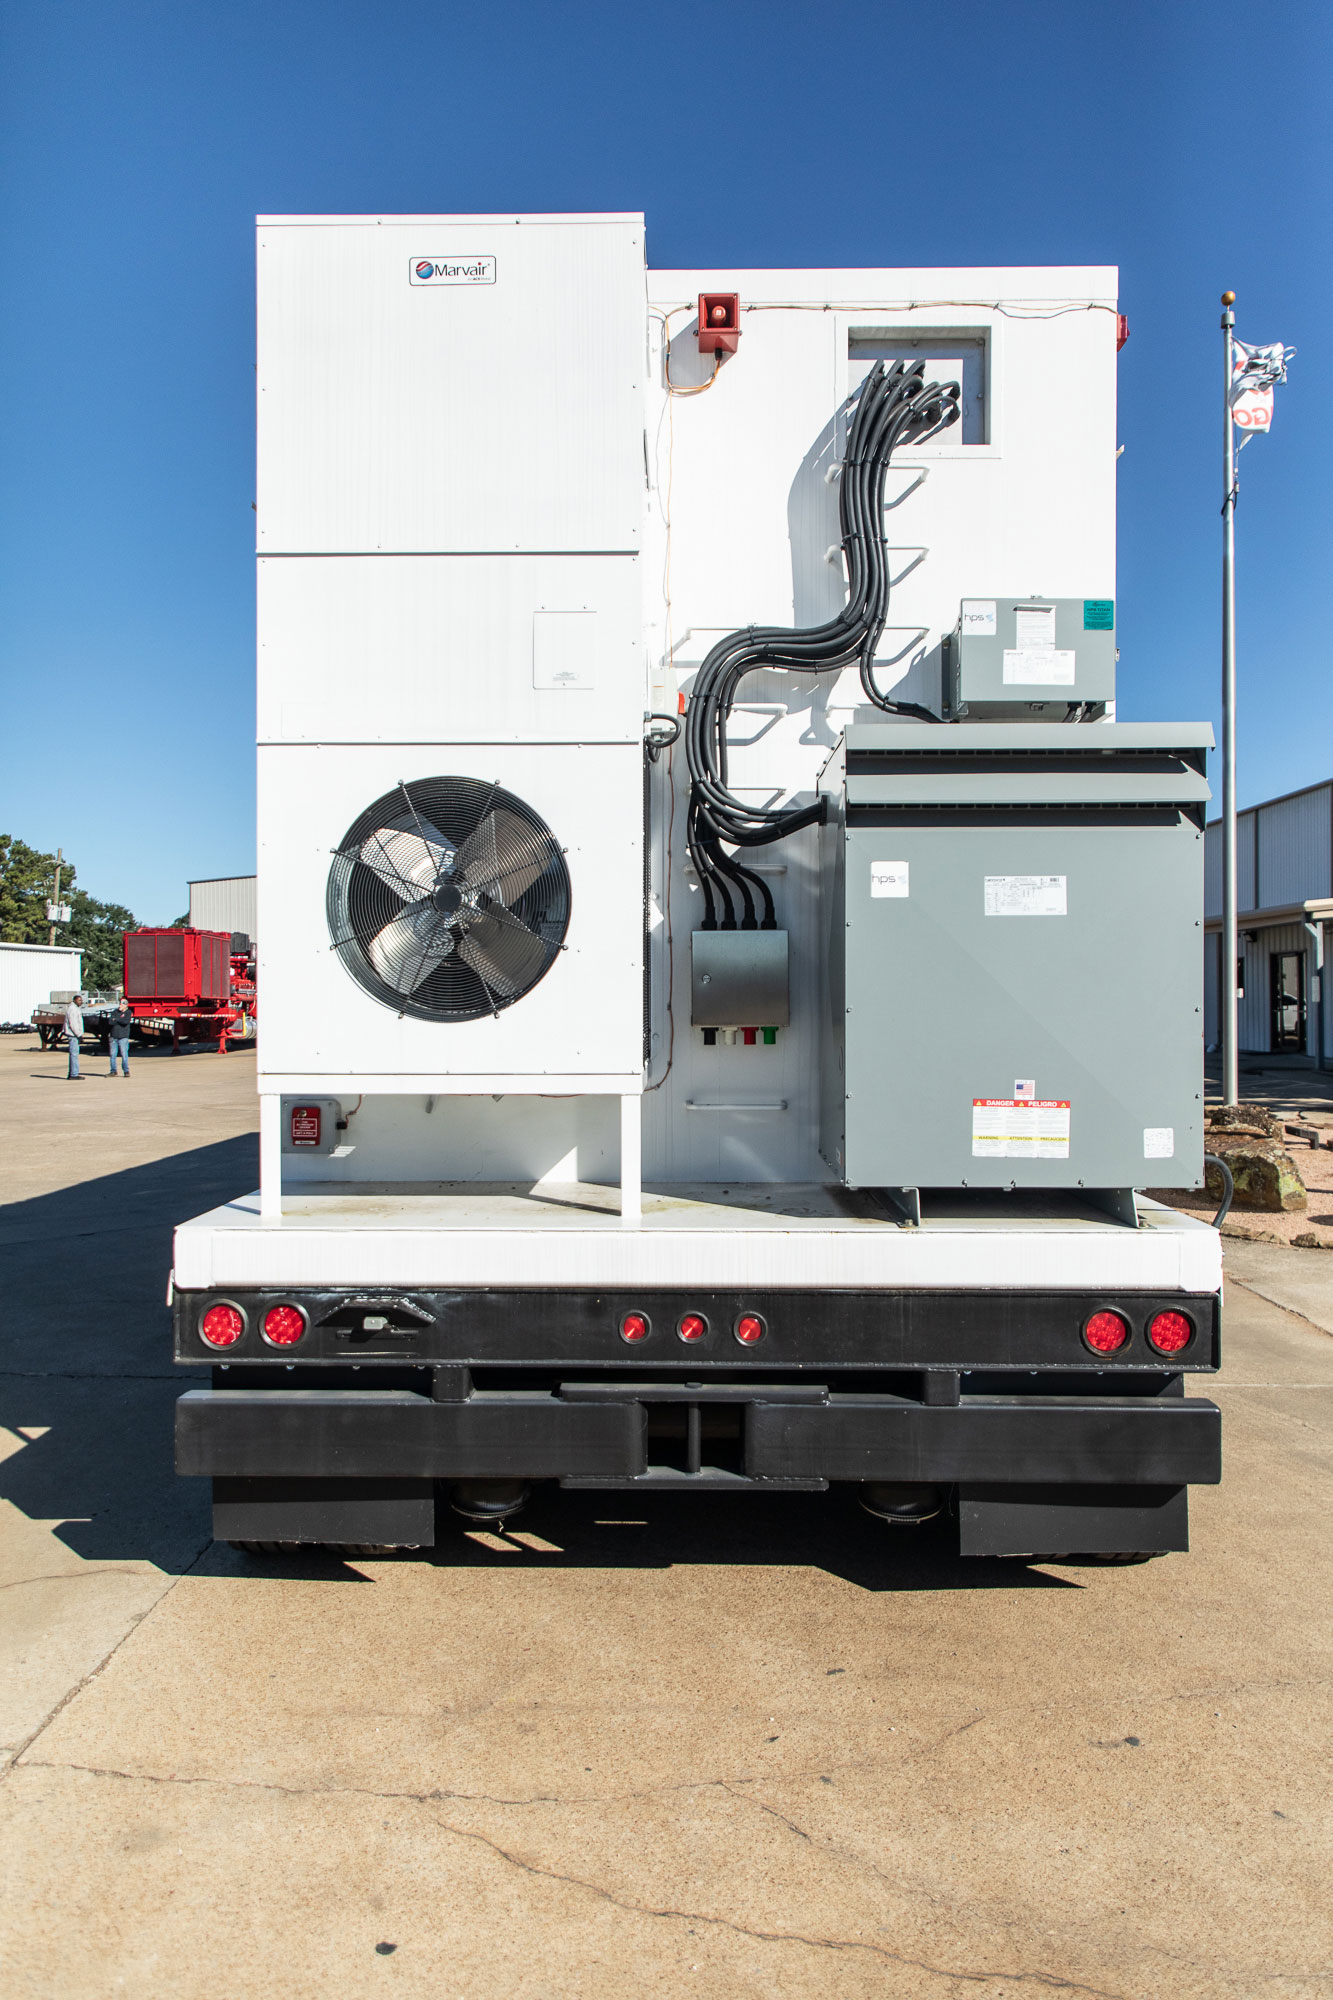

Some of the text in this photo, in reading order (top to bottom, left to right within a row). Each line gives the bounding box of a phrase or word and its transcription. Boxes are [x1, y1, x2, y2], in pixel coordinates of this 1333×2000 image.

[435, 262, 488, 277] Marvair
[964, 613, 985, 623] hps
[871, 873, 896, 885] hps
